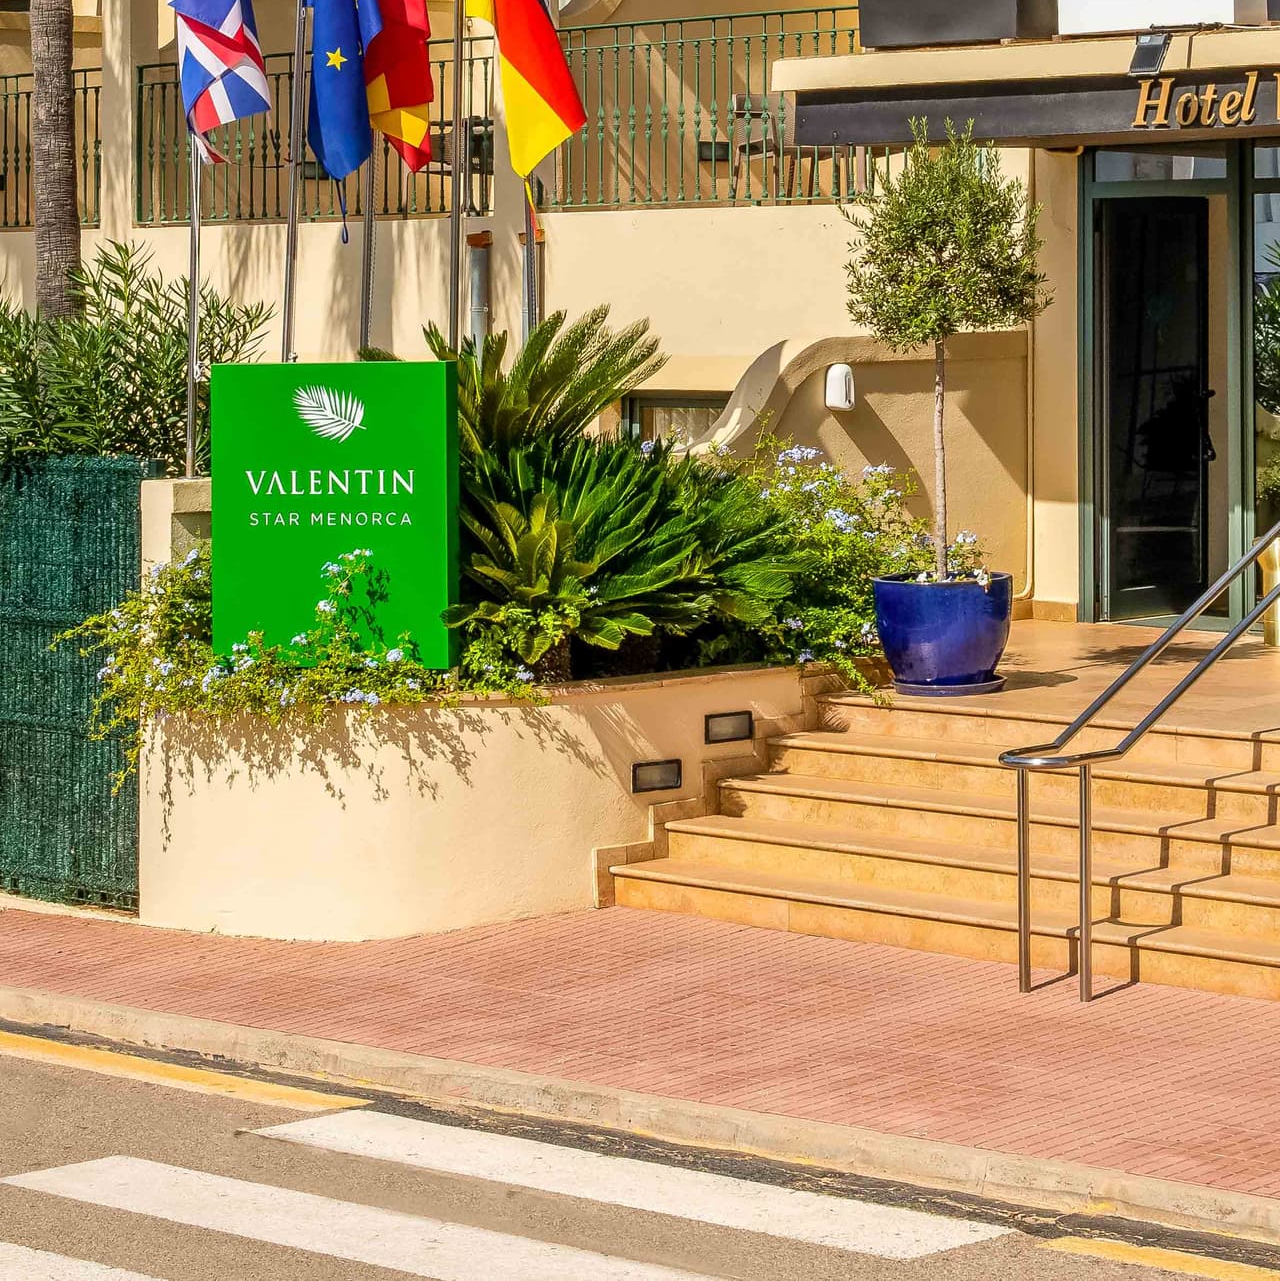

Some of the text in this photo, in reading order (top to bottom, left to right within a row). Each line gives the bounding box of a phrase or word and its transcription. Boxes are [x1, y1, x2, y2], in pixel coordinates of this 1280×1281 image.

[1132, 70, 1259, 126] Hotel
[245, 469, 415, 495] VALENTIN
[249, 512, 413, 526] STAR MENORCA
